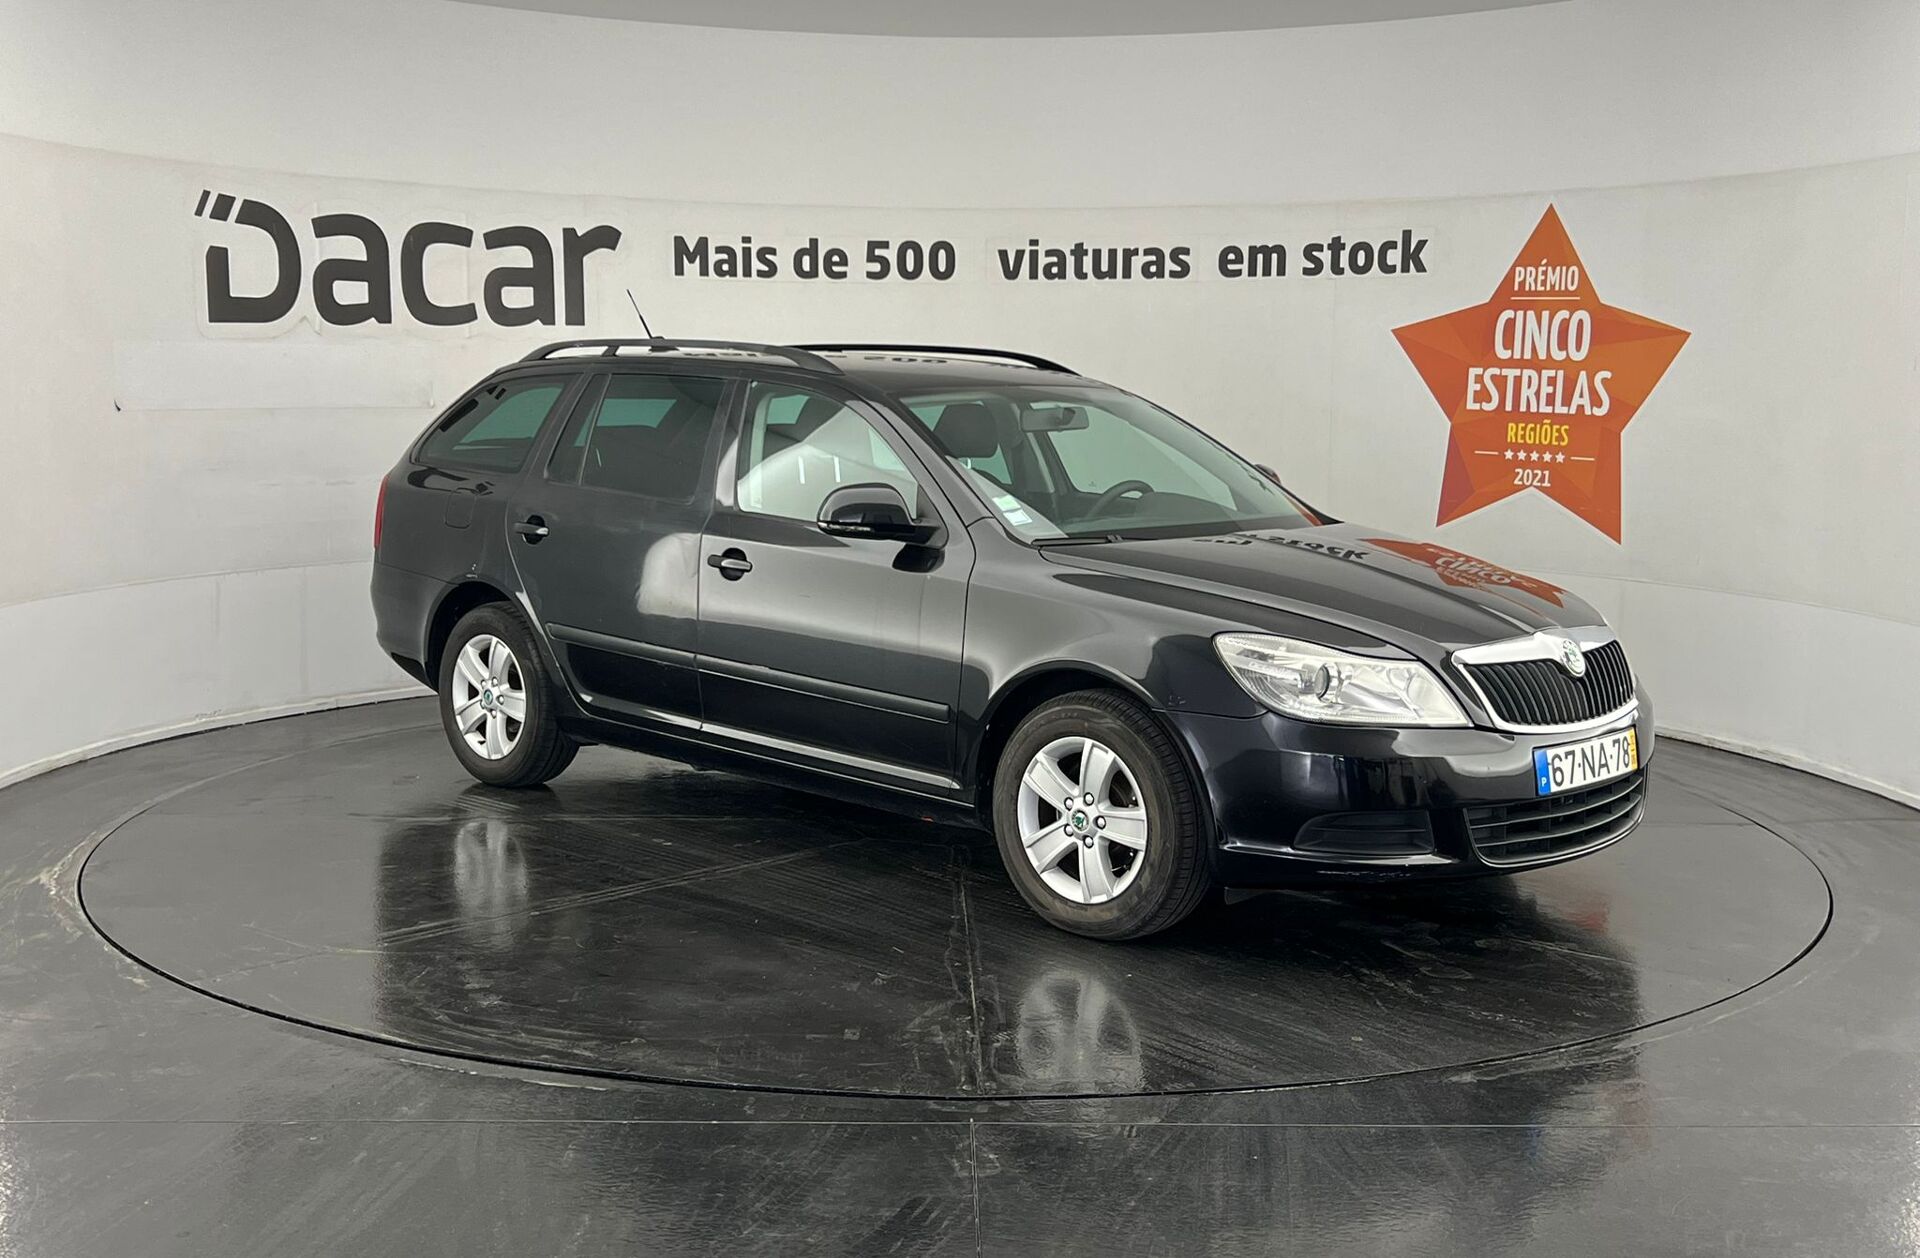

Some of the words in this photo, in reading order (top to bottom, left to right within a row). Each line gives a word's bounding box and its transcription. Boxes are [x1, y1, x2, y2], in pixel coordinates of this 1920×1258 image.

[195, 190, 622, 327] Dacar
[673, 235, 778, 279] Mais
[793, 237, 849, 280] de
[865, 240, 956, 281] 500
[997, 238, 1191, 281] viaturas
[1218, 244, 1287, 279] em
[1302, 229, 1429, 277] stock
[1513, 258, 1580, 292] PRÉMIO
[1494, 309, 1592, 361] CINCO
[1466, 367, 1613, 416] ESTRELAS
[1507, 419, 1569, 446] REGIÕES
[1513, 468, 1551, 487] 2021
